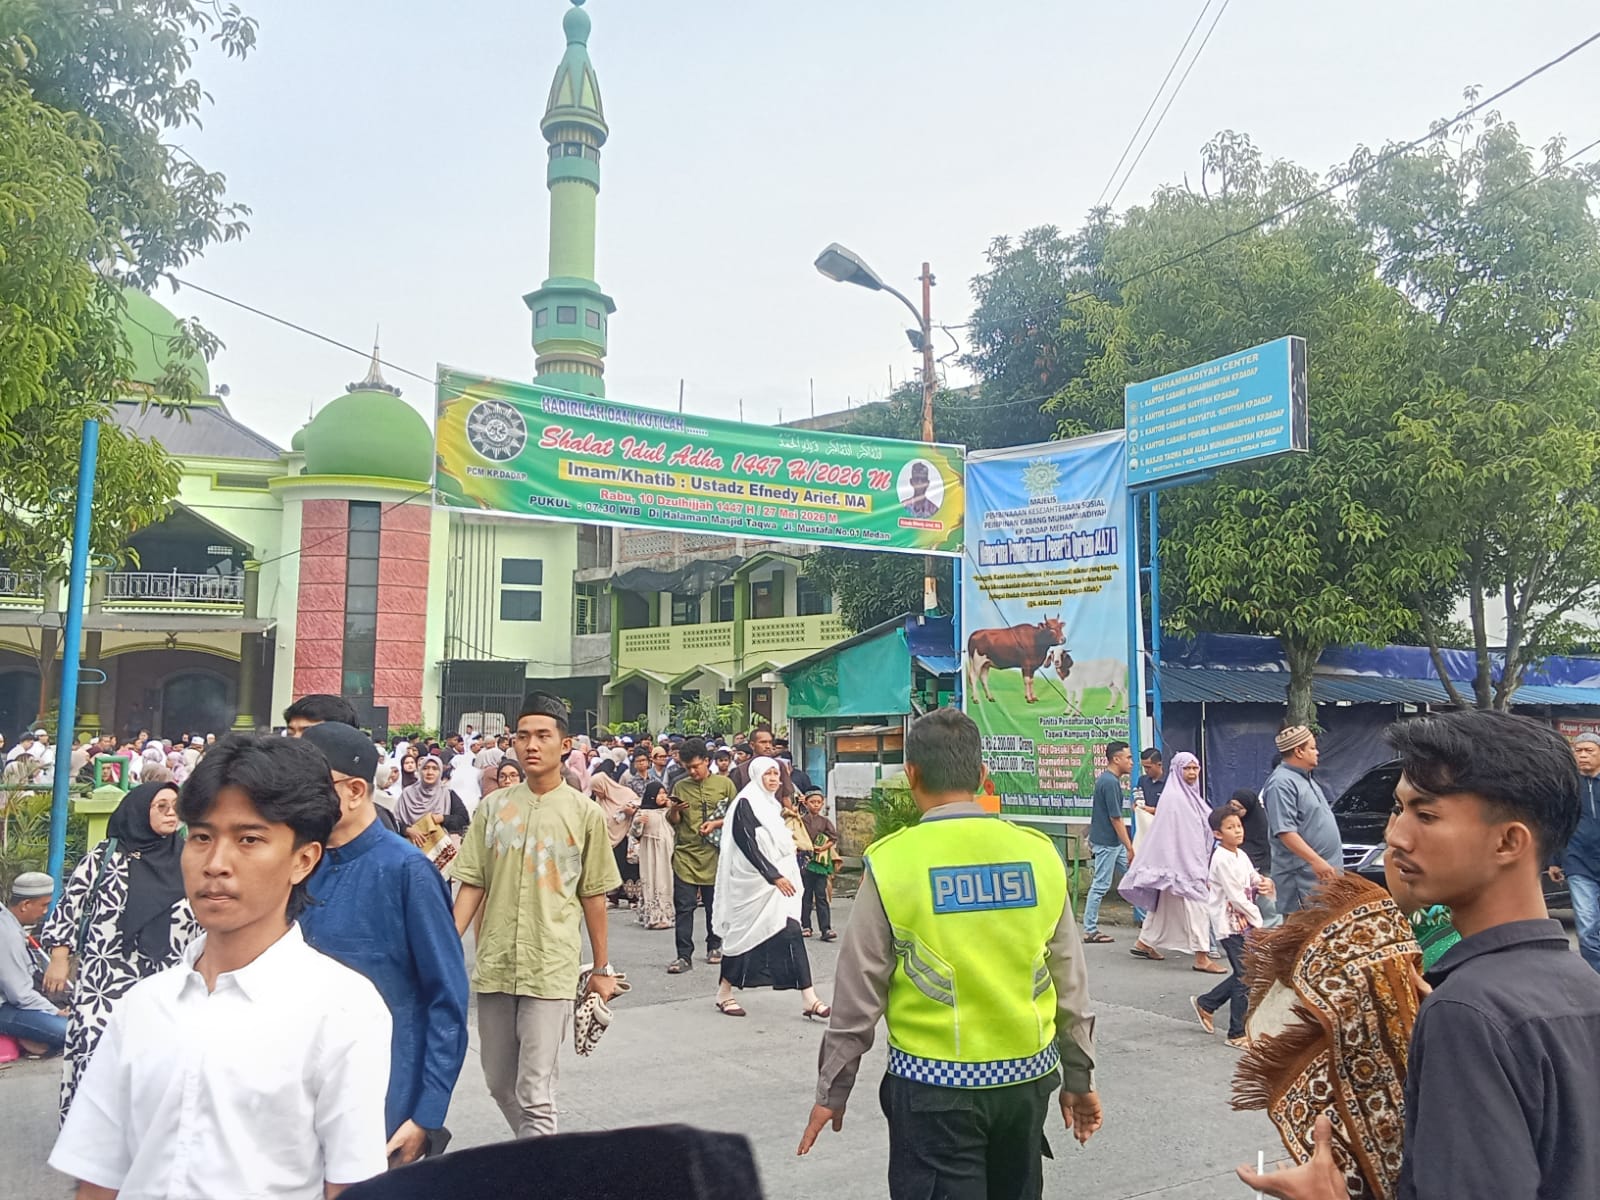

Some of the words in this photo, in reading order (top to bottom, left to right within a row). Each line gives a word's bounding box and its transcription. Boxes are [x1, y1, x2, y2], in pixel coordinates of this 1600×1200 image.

[1152, 366, 1219, 391] MUHAMMADIYAH
[1222, 353, 1258, 370] CENTER
[542, 396, 605, 420] HADIRILAH
[608, 408, 631, 424] DAN
[540, 427, 614, 456] Shalat
[621, 438, 664, 461] Idul
[669, 445, 722, 469] Adha
[732, 453, 782, 476] 1447
[788, 459, 862, 485] H/2026
[868, 469, 891, 489] M
[568, 462, 675, 487] Imam/Khatib
[691, 477, 744, 495] Ustadz
[749, 484, 799, 504] Efnedy
[845, 496, 866, 507] MA
[1030, 496, 1056, 505] MAJELIS
[530, 496, 571, 508] PUKUL
[620, 505, 641, 516] WIB
[649, 509, 659, 517] Di
[663, 512, 708, 523] Halaman
[711, 515, 743, 527] Masjid
[746, 519, 777, 530] Taqwa
[797, 525, 832, 535] Mustafa
[863, 530, 890, 540] Medan
[601, 490, 635, 504] Rabu,
[640, 494, 652, 504] 10
[657, 495, 713, 511] Dzulhijjah
[717, 502, 742, 513] 1447
[746, 505, 754, 514] H
[763, 507, 776, 516] 27
[780, 509, 798, 519] Mei
[801, 511, 826, 522] 2026
[829, 513, 837, 523] M
[1050, 524, 1073, 532] MEDAN
[935, 871, 1032, 905] POLISI
